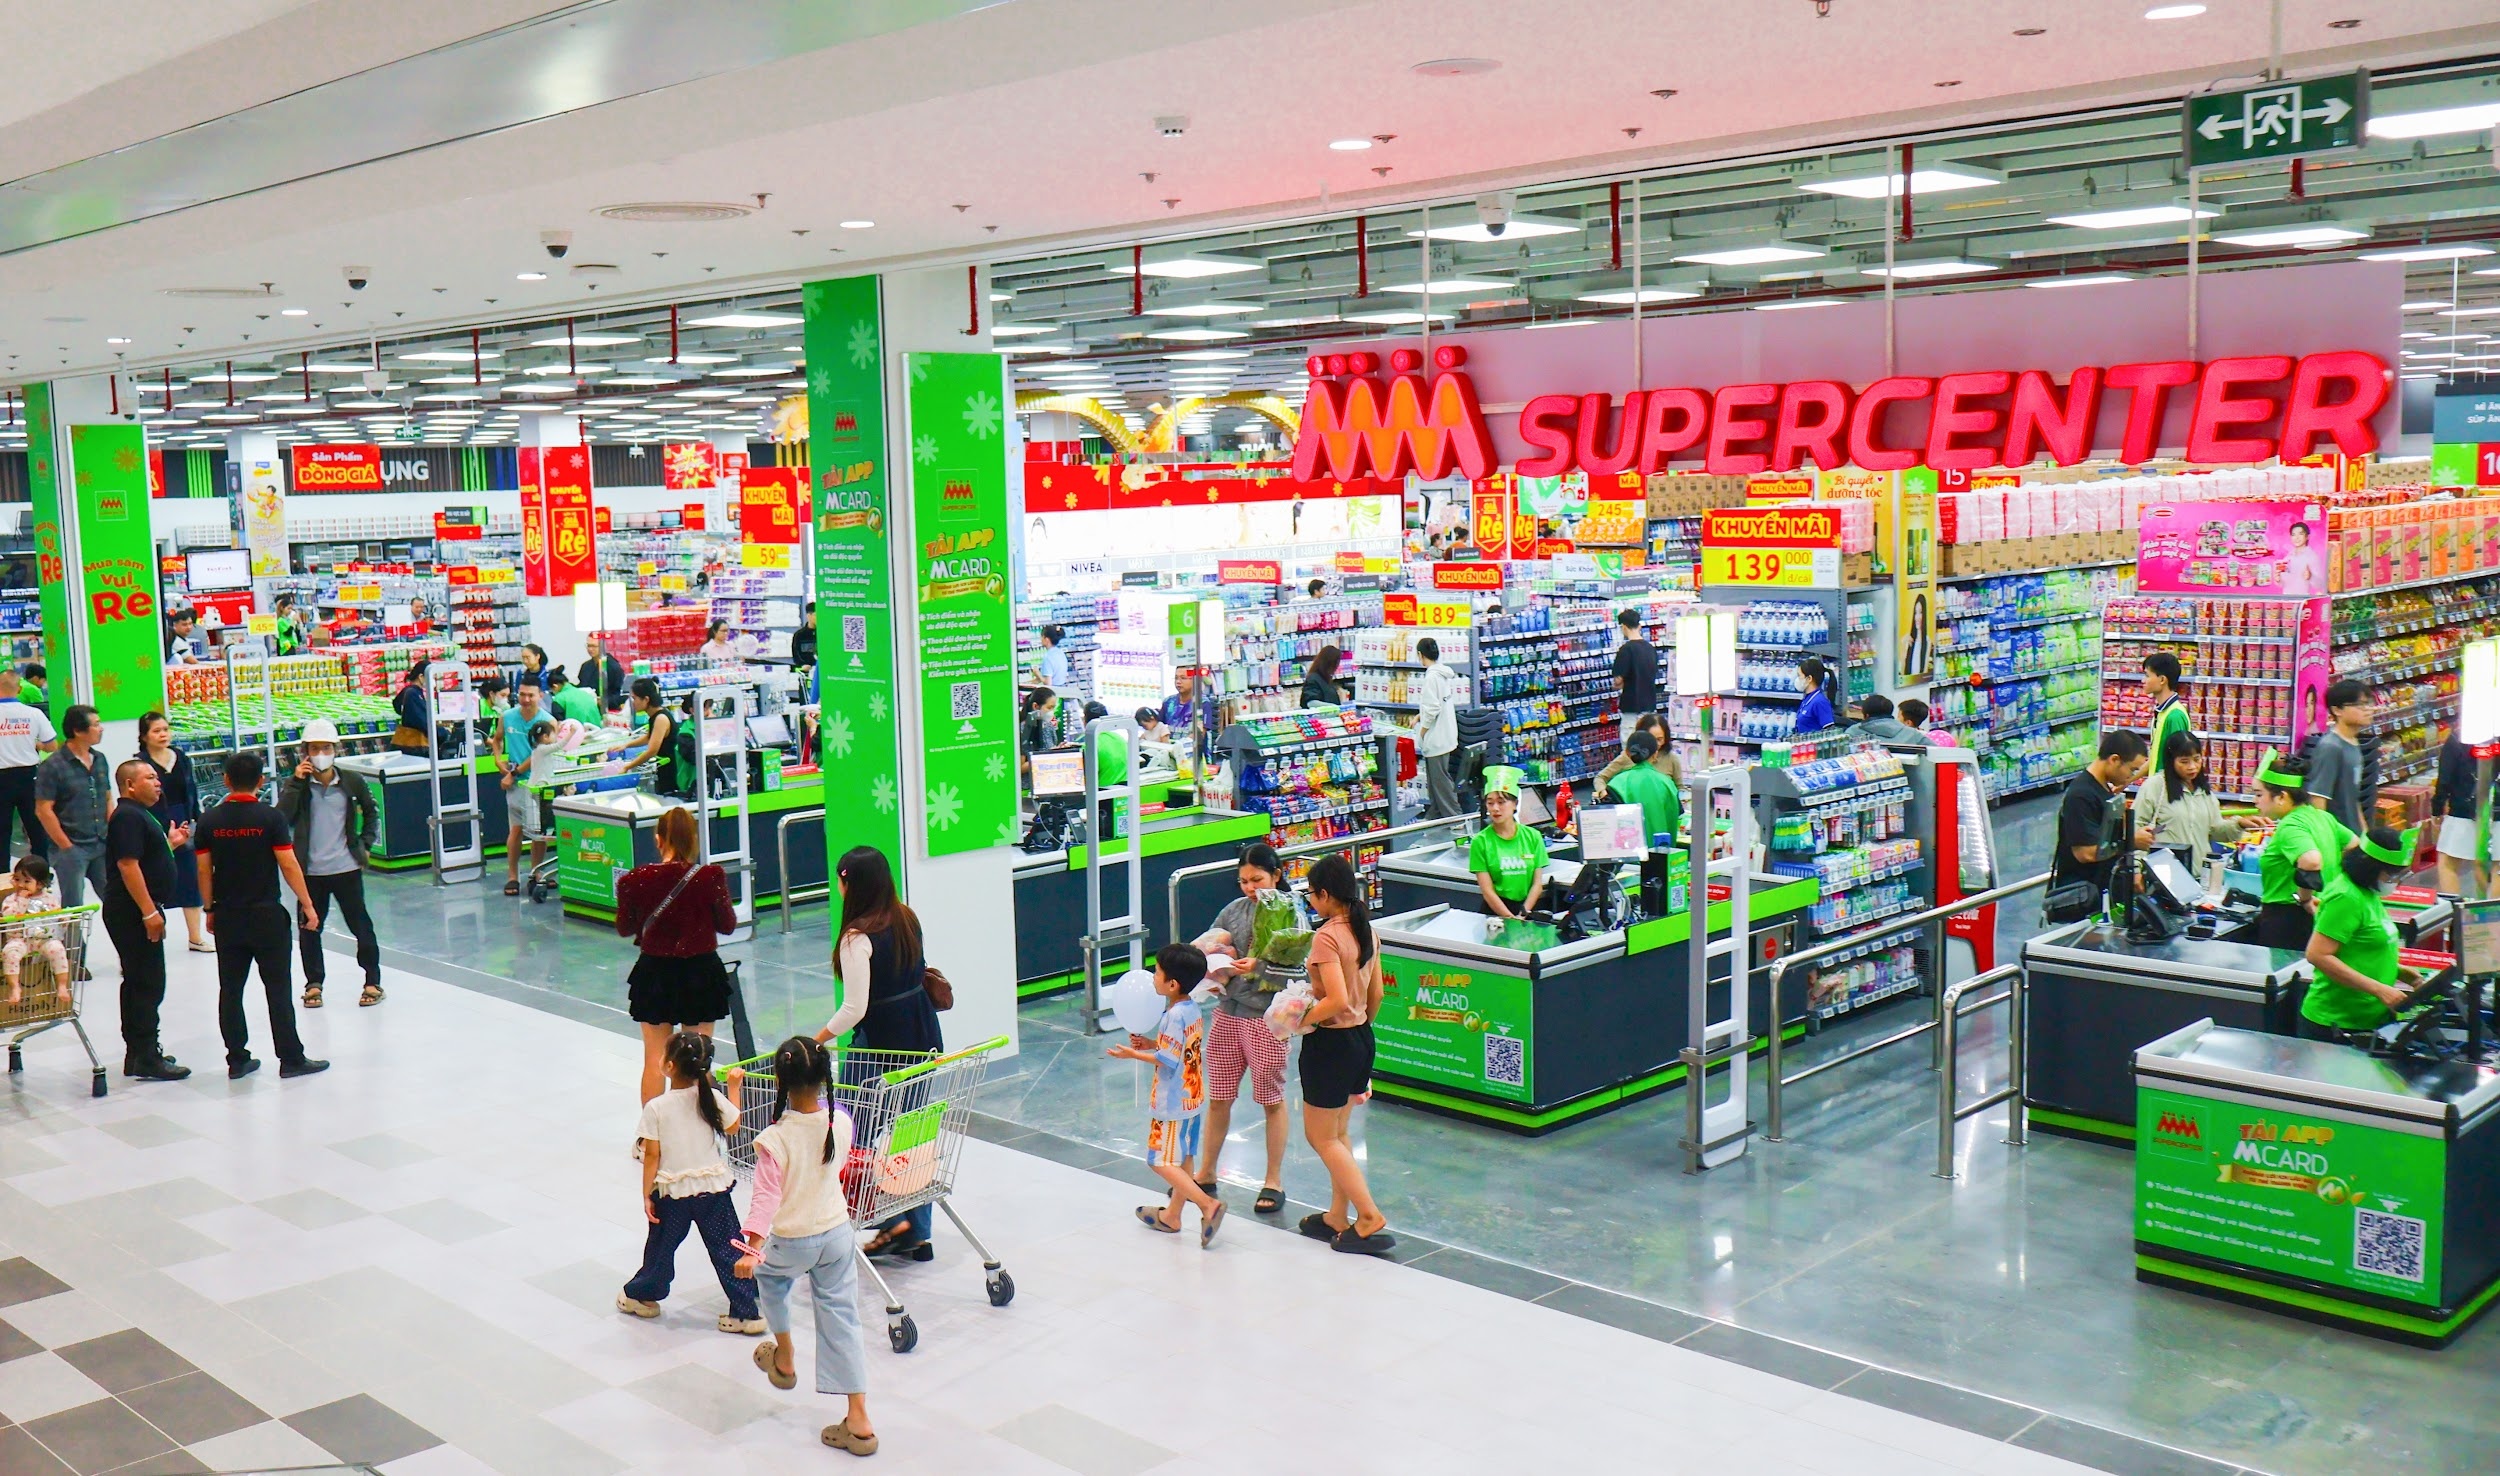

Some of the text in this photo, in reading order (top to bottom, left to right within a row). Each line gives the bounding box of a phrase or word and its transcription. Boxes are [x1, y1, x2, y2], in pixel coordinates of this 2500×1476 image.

[1515, 350, 2394, 478] SUPERCENTER
[312, 451, 363, 462] Sản Phẩm
[299, 463, 378, 484] ĐỒNG GIÁ
[380, 459, 430, 486] ỤNG
[822, 460, 875, 490] TẢI APP
[1619, 471, 1641, 488] MÃI
[1834, 473, 1874, 488] Bí quyết
[1943, 468, 1966, 486] 15
[743, 482, 787, 504] KHUYẾN
[1751, 480, 1809, 495] KHUYẾN MÃI
[1827, 487, 1883, 499] dưỡng tóc
[825, 490, 872, 511] MCARD
[772, 504, 795, 525] MÃI
[1598, 503, 1622, 517] 245
[1479, 514, 1504, 539] Rẻ
[1712, 511, 1832, 539] KHUYẾN MÃI
[559, 527, 587, 553] Rẻ
[926, 528, 995, 560] TẢI APP
[2195, 519, 2269, 558] 25
[760, 547, 777, 565] 59
[84, 559, 113, 574] Mua
[929, 557, 992, 580] MCARD
[1071, 562, 1103, 574] NIVEA
[1223, 564, 1276, 580] KHUYẾN MÃI
[1383, 559, 1390, 572] 9
[1726, 553, 1781, 581] 139
[100, 571, 133, 589] vui
[480, 571, 506, 583] 199
[1437, 567, 1499, 584] KHUYẾN MÃI
[91, 584, 154, 626] Rẻ
[189, 595, 214, 604] Tefal
[1183, 609, 1194, 628] 6
[1420, 606, 1456, 624] 189
[255, 622, 268, 633] 45
[0, 729, 31, 737] TRONGER
[13, 722, 31, 730] are
[213, 827, 265, 838] SECURITY
[1419, 970, 1473, 989] TẢI APP
[1415, 986, 1469, 1011] MCARD
[2239, 1118, 2335, 1147] TẢI APP
[2232, 1139, 2329, 1176] MCARD
